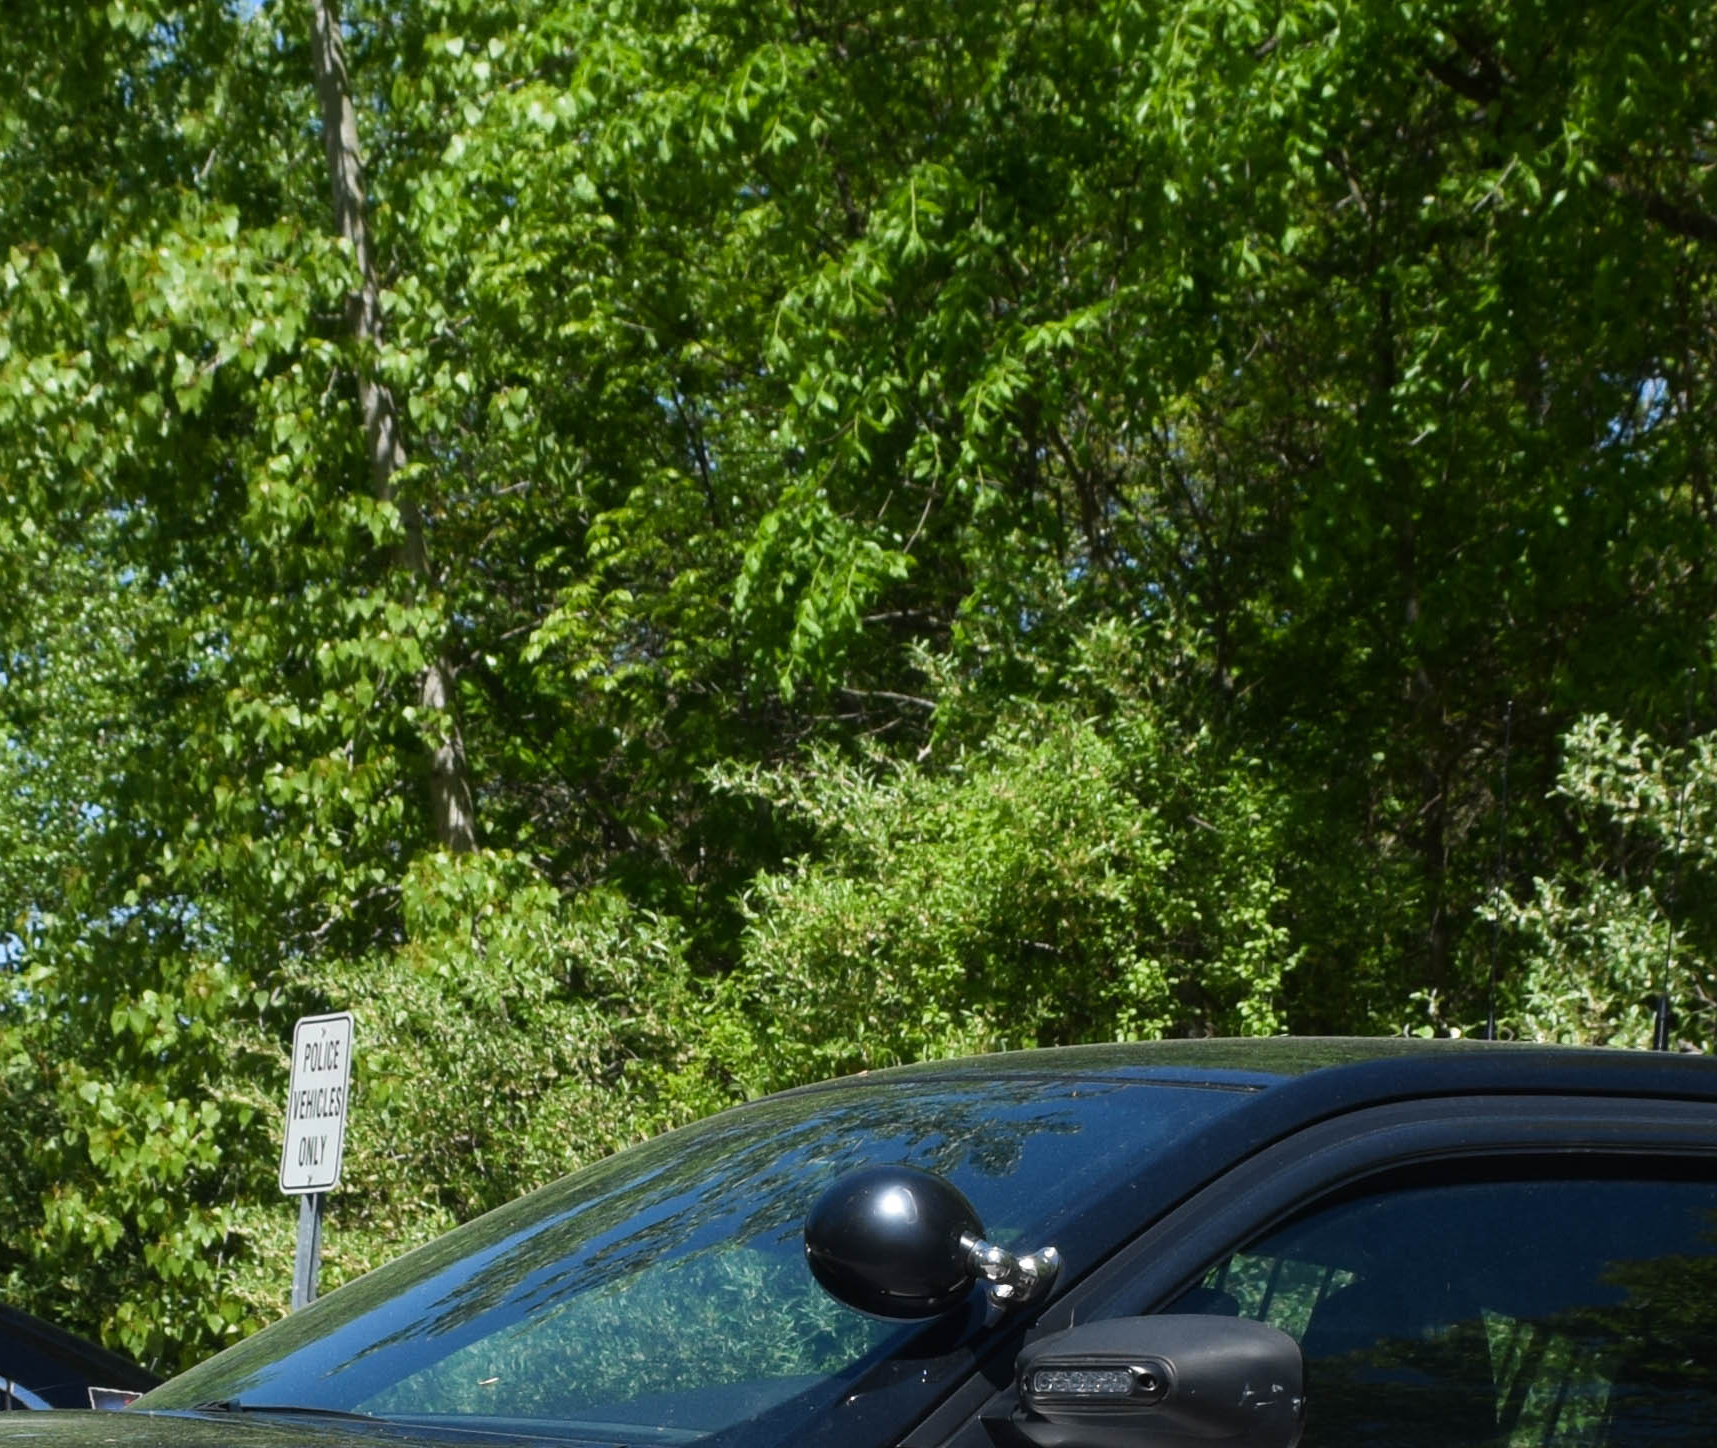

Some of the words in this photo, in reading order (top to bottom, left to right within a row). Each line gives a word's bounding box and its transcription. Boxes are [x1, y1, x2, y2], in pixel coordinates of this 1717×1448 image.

[303, 1040, 340, 1072] POLICE
[293, 1086, 342, 1120] VEHICLES
[298, 1134, 328, 1167] ONLY
